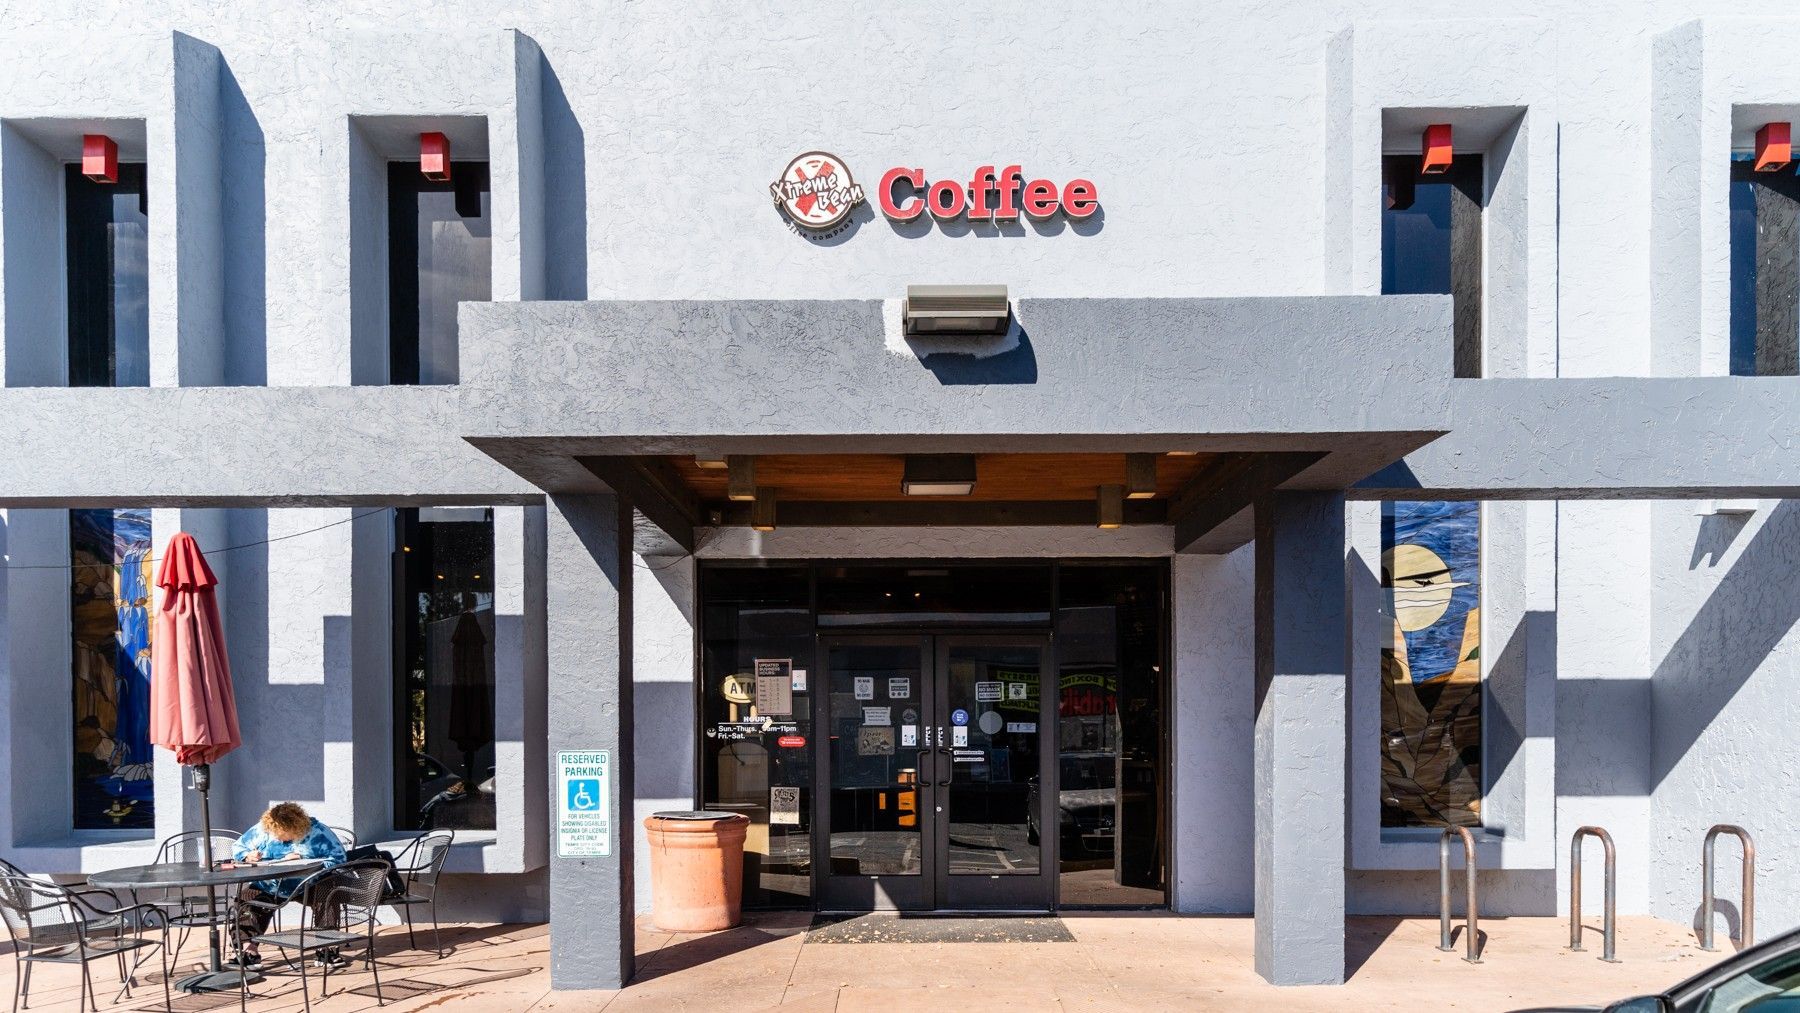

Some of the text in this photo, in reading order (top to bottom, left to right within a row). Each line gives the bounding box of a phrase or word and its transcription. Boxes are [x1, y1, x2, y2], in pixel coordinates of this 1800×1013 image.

[769, 172, 838, 202] Xtreme
[817, 184, 864, 211] Bean
[878, 165, 1098, 221] Coffee
[812, 218, 854, 241] company
[730, 682, 757, 694] ATM
[561, 754, 607, 764] RESERVED
[565, 767, 603, 776] PARKING
